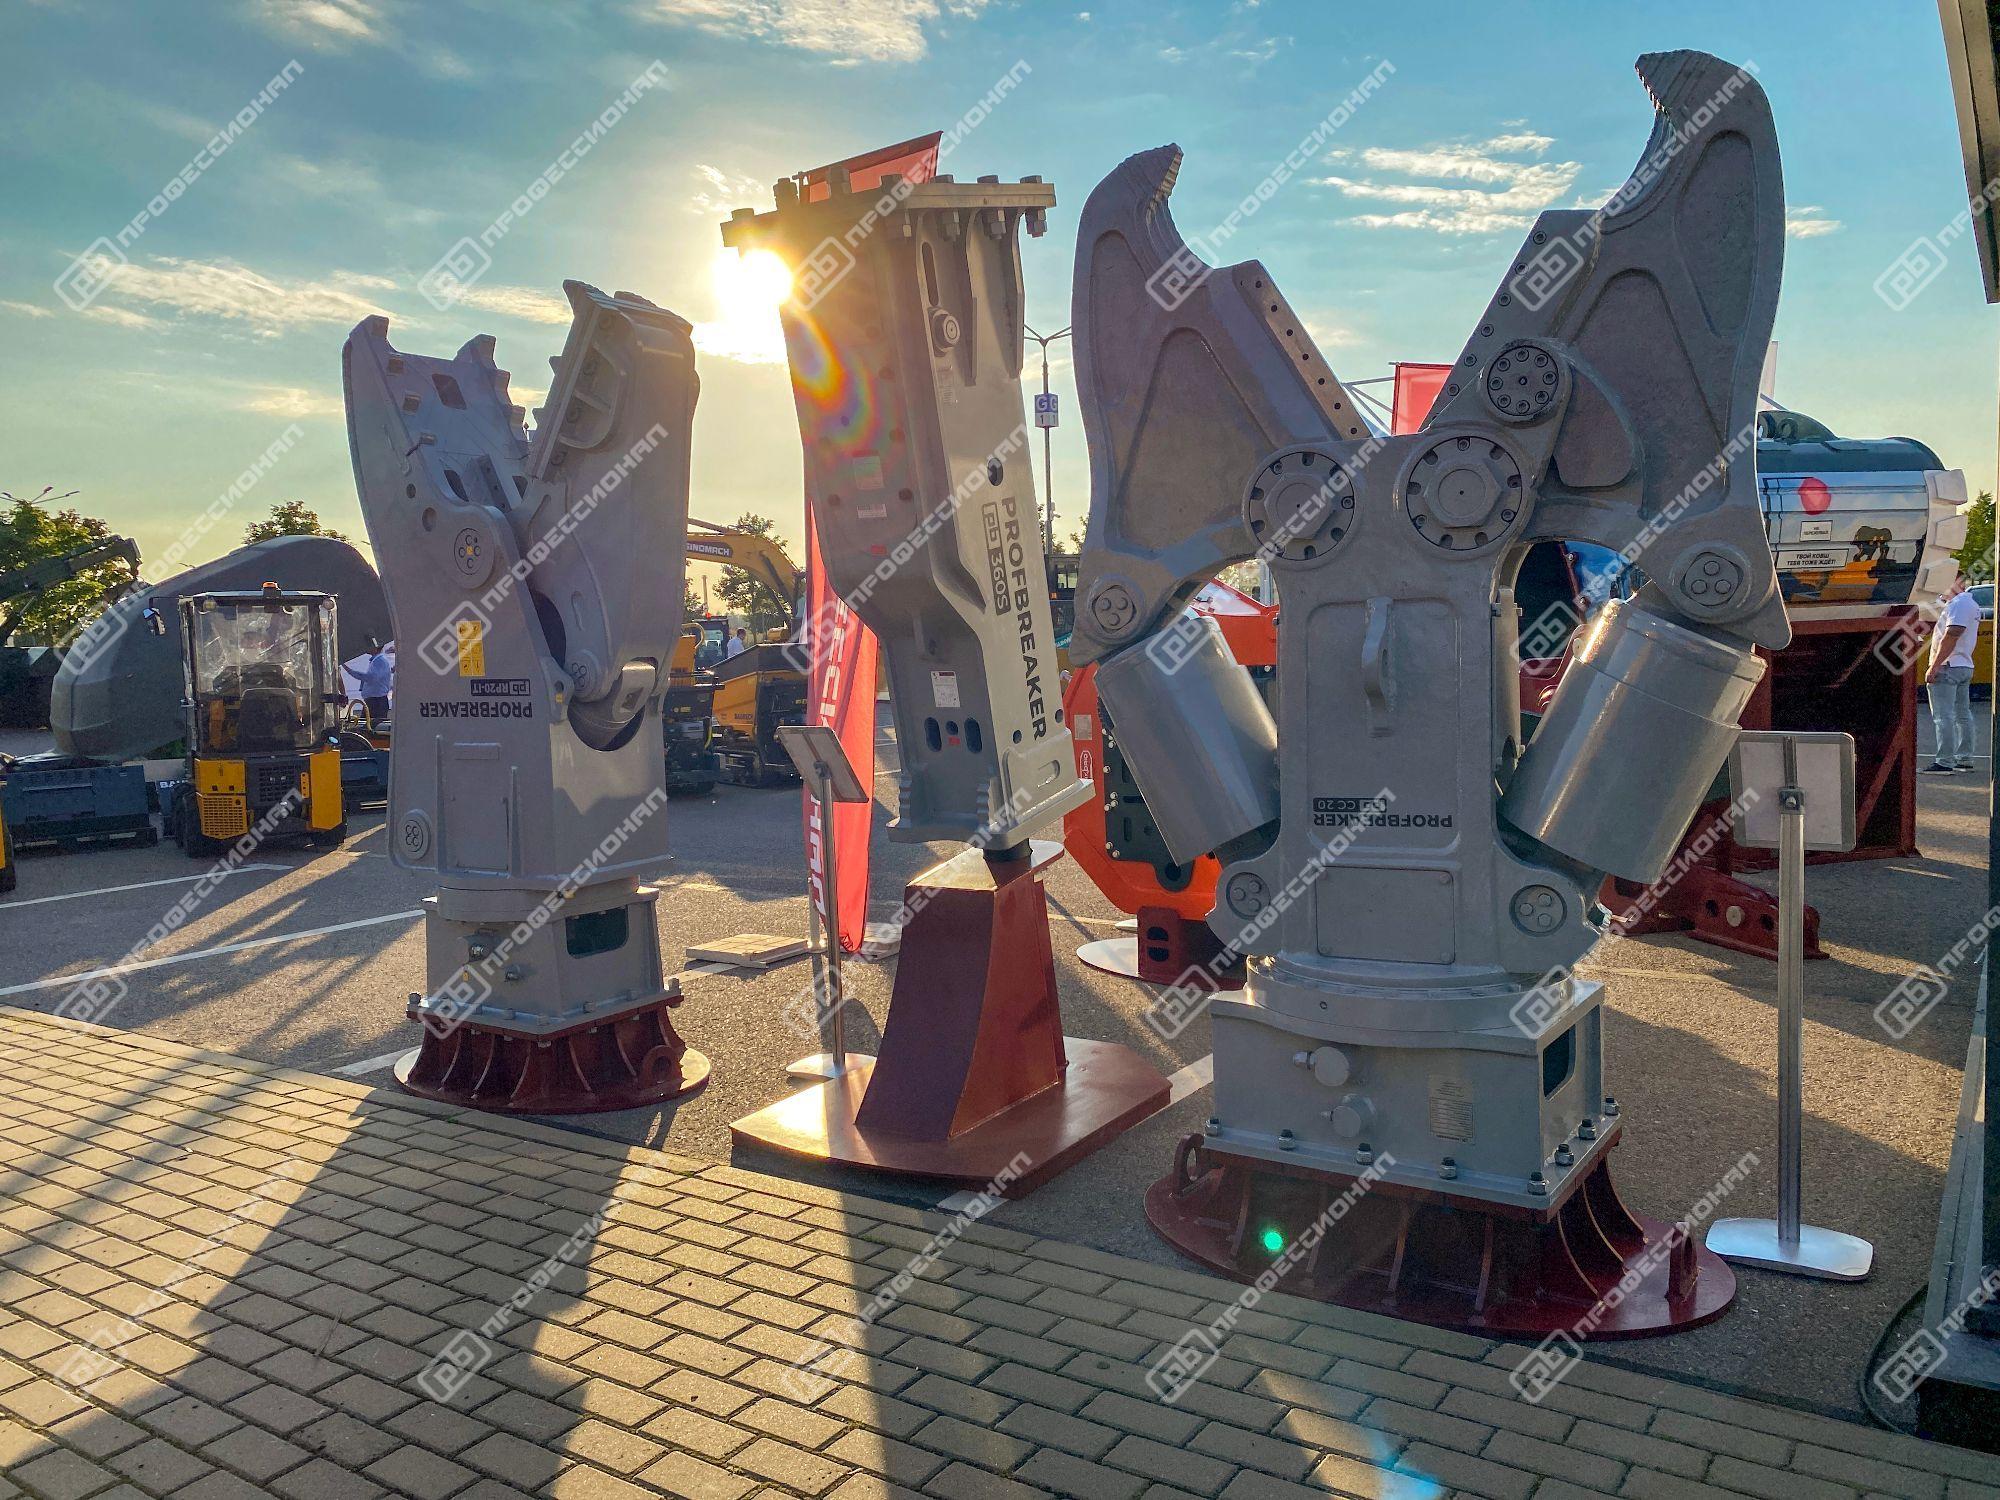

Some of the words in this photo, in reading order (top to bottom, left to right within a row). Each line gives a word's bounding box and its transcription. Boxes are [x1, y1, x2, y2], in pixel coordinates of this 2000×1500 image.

[1036, 397, 1047, 411] G
[1040, 415, 1044, 424] 1
[990, 553, 1009, 611] 360S
[1001, 497, 1047, 739] PROFBREAKER
[472, 682, 509, 694] RP20-IT
[420, 701, 532, 718] PROFBREAKER
[1318, 800, 1334, 810] 20
[1313, 814, 1453, 828] PROFBREAKER
